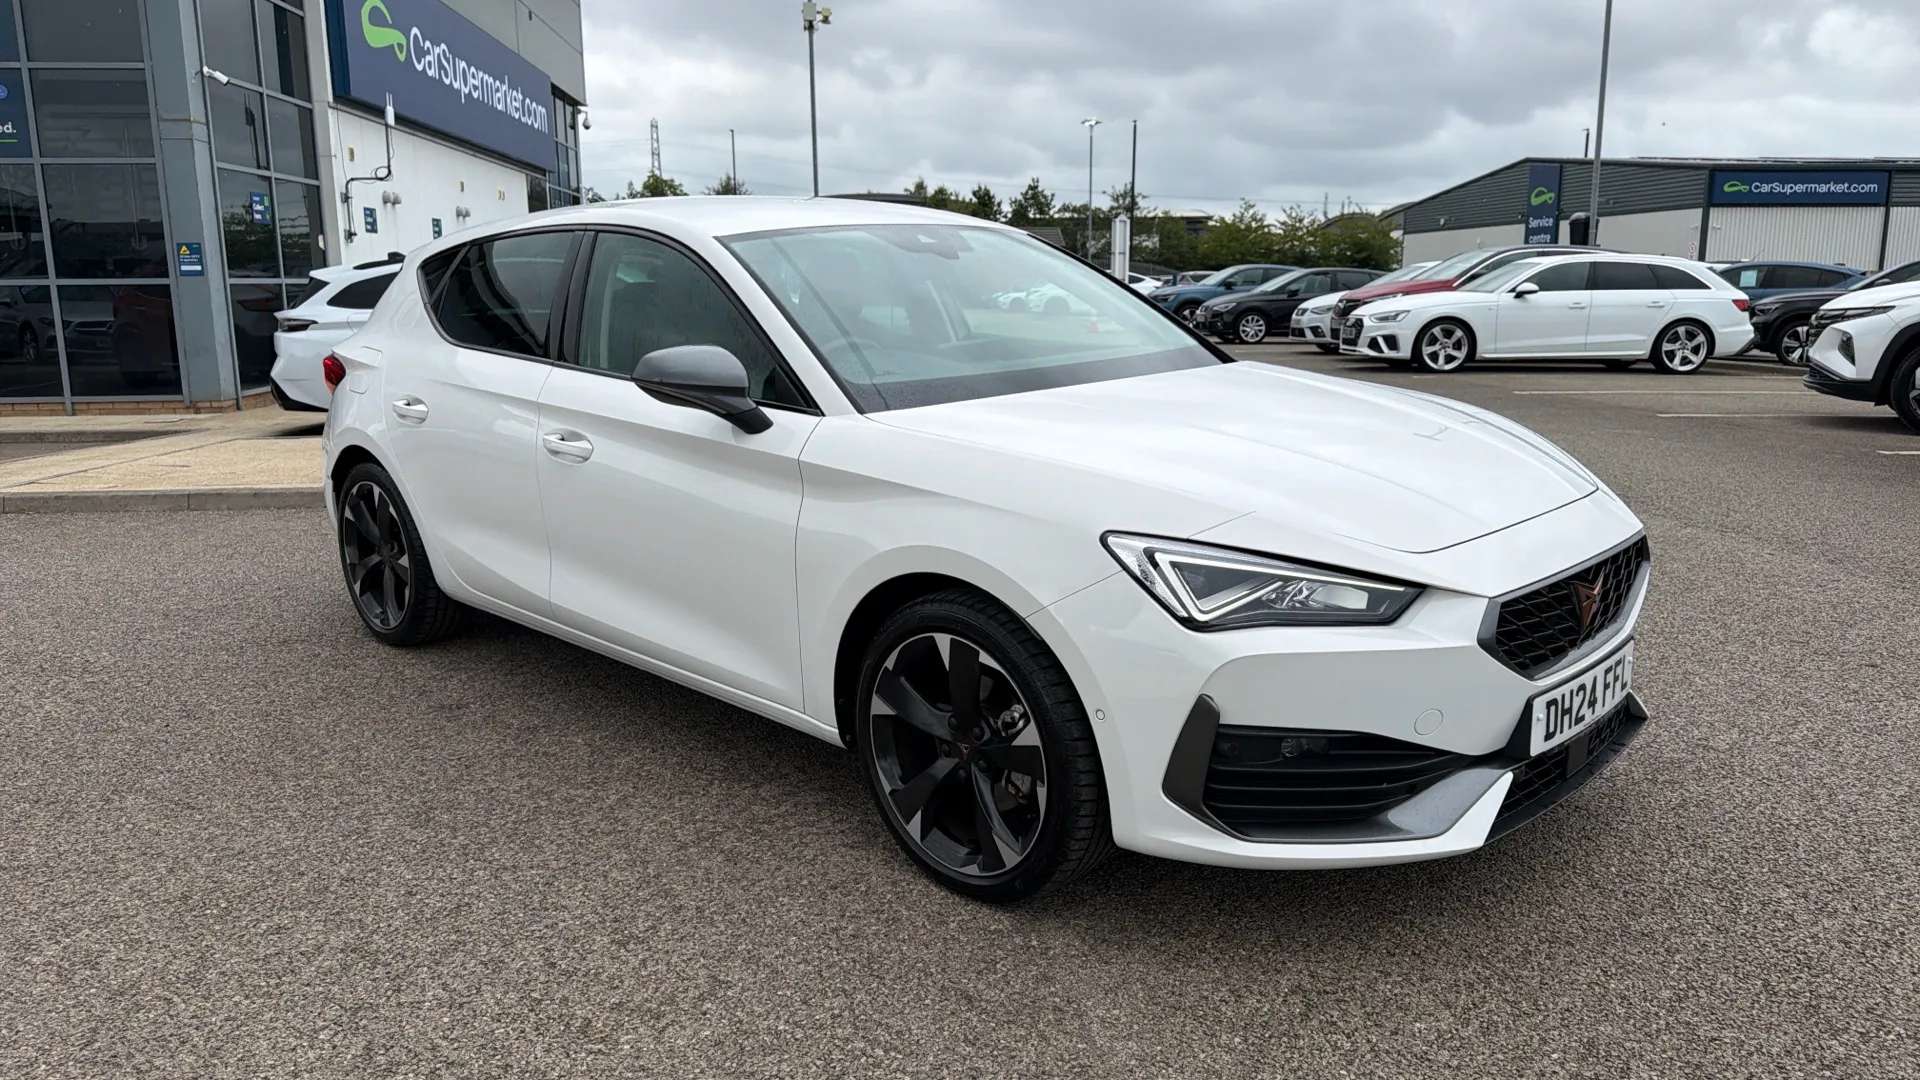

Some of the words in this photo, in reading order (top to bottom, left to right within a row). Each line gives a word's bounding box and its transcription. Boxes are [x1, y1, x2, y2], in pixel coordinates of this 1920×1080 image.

[410, 26, 549, 134] CarSupermarket.com
[1751, 181, 1878, 196] CarSupermarket.com
[1528, 215, 1554, 228] Service
[1528, 233, 1551, 244] centre
[1544, 675, 1598, 743] DH24
[1602, 654, 1628, 708] FFL
